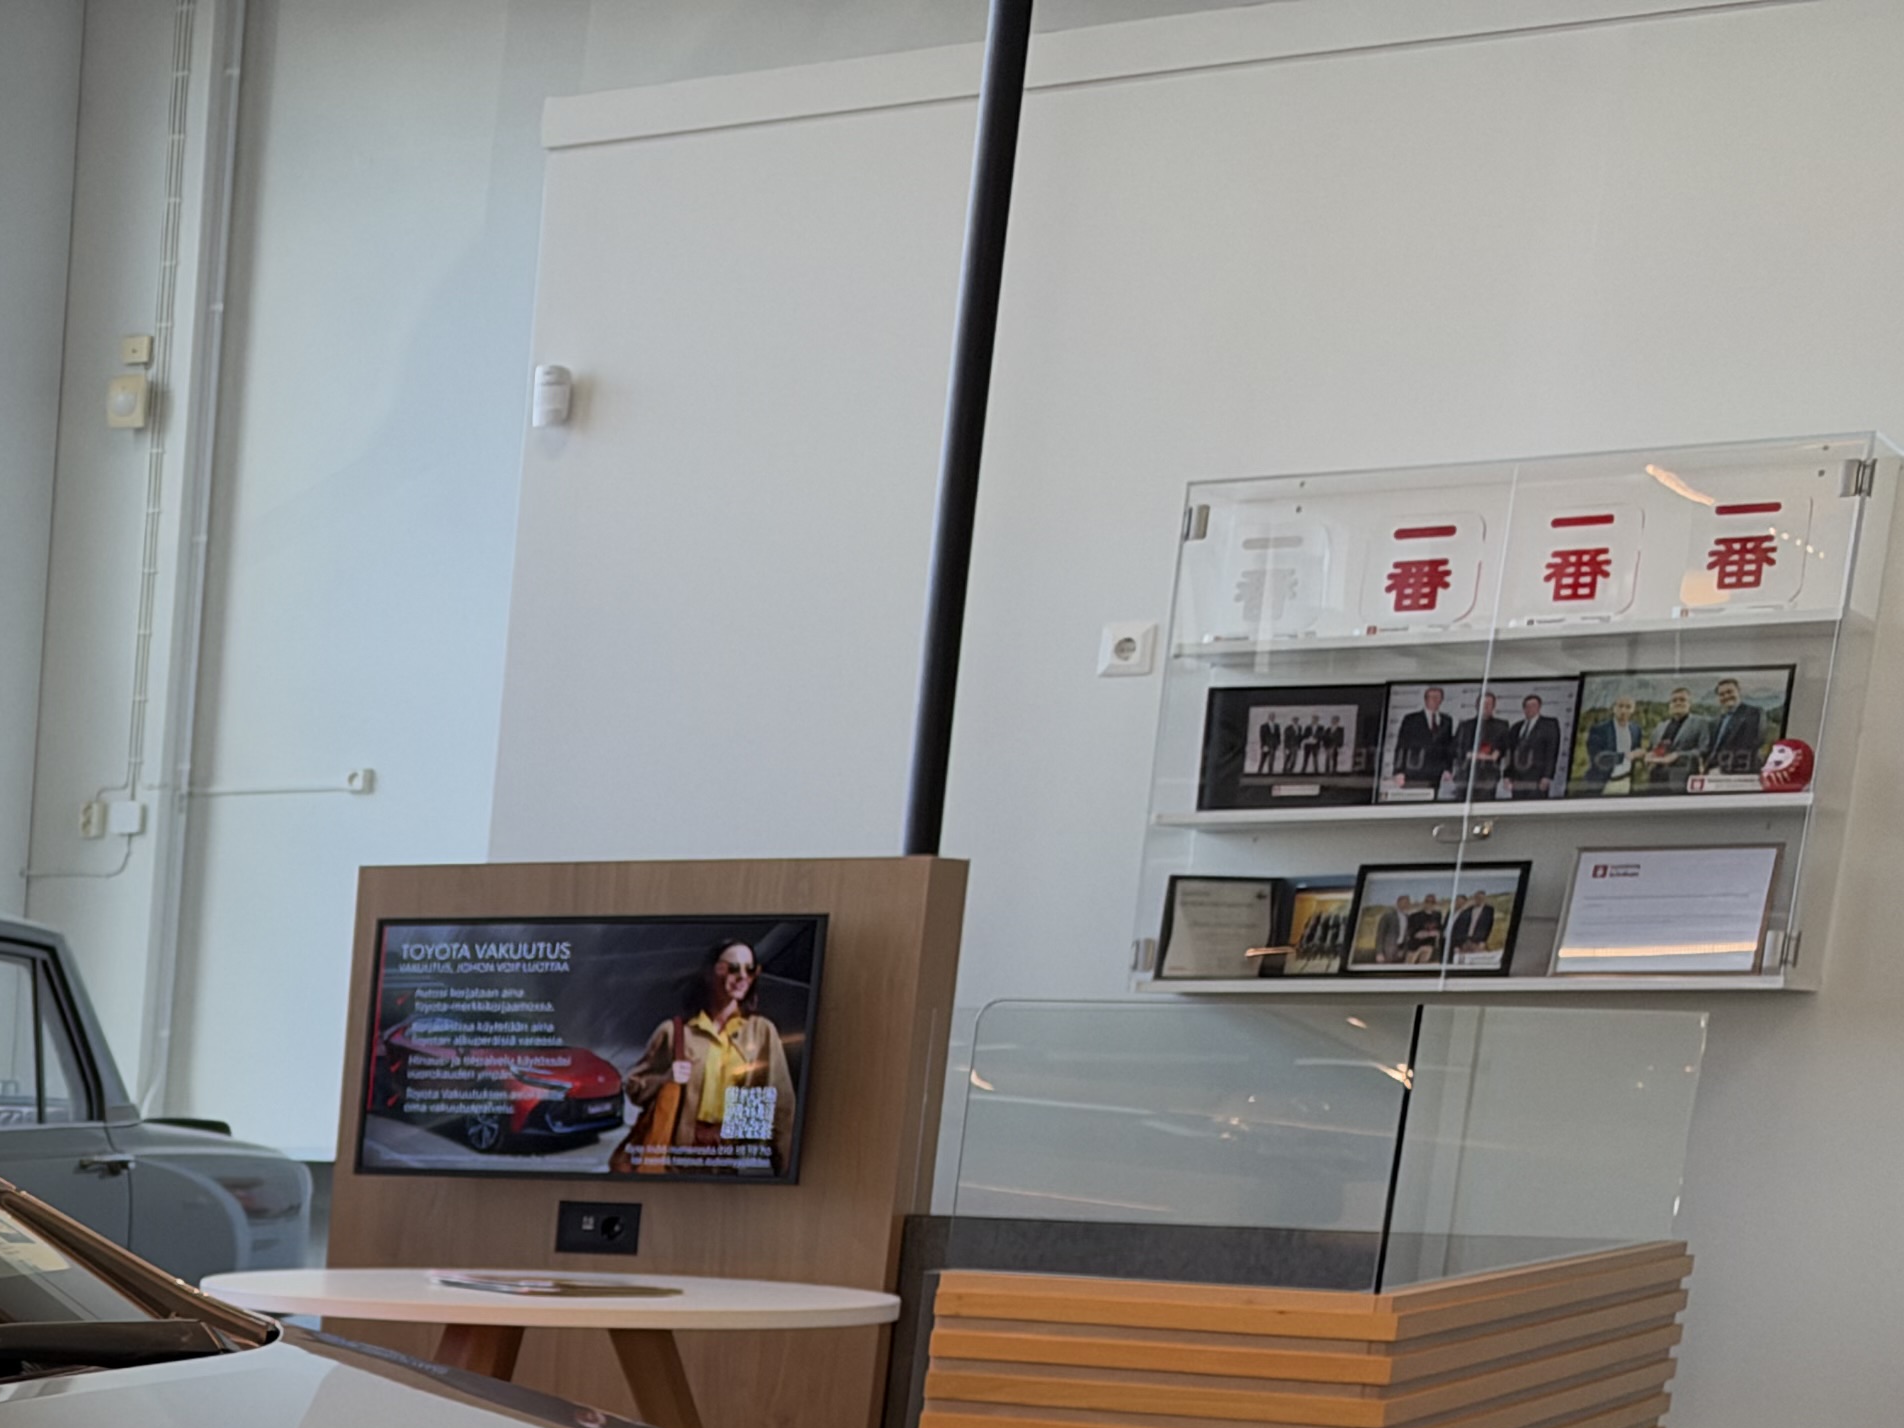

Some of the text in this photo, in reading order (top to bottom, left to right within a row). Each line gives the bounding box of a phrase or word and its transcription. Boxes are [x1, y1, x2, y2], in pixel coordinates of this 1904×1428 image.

[1384, 525, 1458, 612] 一番
[1543, 513, 1615, 602] 一番
[1709, 502, 1782, 590] 一番
[400, 942, 572, 961] TOYOTA VAKUUTUS
